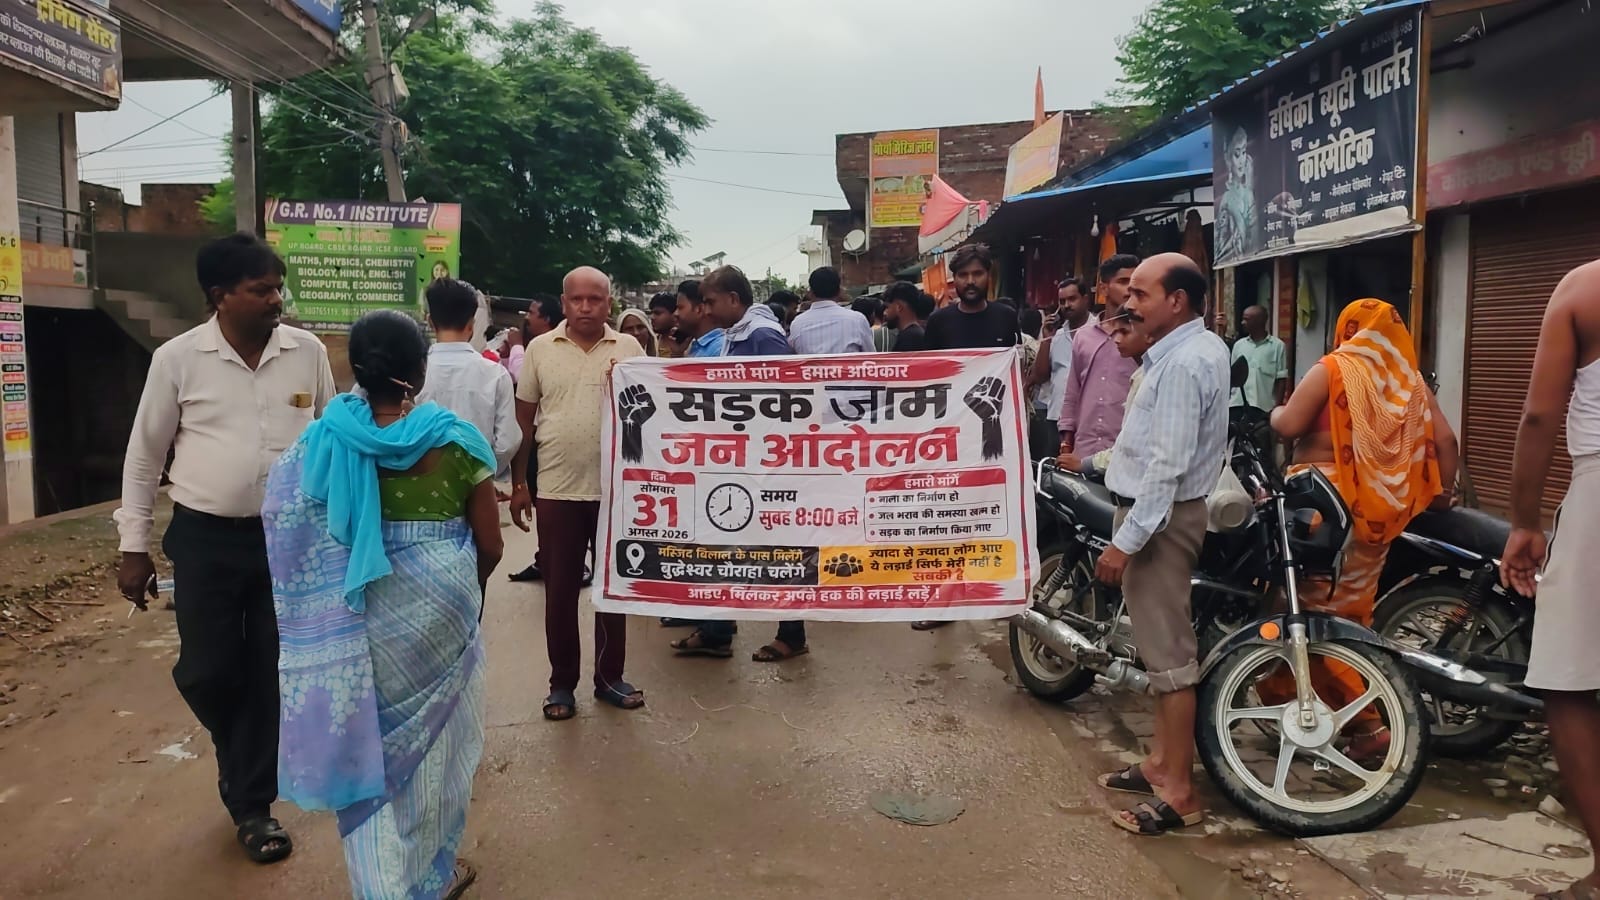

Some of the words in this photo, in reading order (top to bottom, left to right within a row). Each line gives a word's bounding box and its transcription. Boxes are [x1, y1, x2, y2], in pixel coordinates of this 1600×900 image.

[1268, 91, 1315, 140] हर्षिका
[1318, 65, 1358, 128] ब्यूटी
[1361, 40, 1413, 100] पार्लर
[1297, 127, 1376, 184] कॉस्मेटिक
[279, 202, 309, 218] G.R.
[313, 203, 345, 220] No.1
[349, 205, 429, 223] INSTITUTE
[289, 256, 322, 267] MATHS,
[323, 257, 363, 267] PHYSICS,
[365, 258, 415, 268] CHEMISTRY
[298, 267, 338, 279] BIOLOGY,
[339, 269, 366, 280] HINDI,
[368, 270, 406, 279] ENGLISH
[300, 279, 351, 290] COMPUTER,
[352, 280, 404, 291] ECONOMICS
[299, 290, 354, 302] GEOGRAPHY,
[355, 292, 405, 302] COMMERCE
[705, 364, 746, 380] हमारी
[749, 363, 780, 380] मांग
[800, 365, 842, 380] हमारा
[848, 361, 909, 378] अधिकार
[665, 387, 814, 432] सड़क
[824, 383, 952, 427] जाम
[660, 433, 750, 467] जन
[759, 423, 961, 473] आंदोलन
[650, 471, 667, 482] दिन
[904, 476, 935, 489] हमारी
[937, 473, 960, 487] मांगें
[639, 484, 676, 495] सोमवार
[760, 490, 798, 502] समय
[878, 493, 900, 504] नाला
[902, 493, 915, 503] का
[917, 491, 946, 503] निर्माण
[949, 491, 959, 502] हो
[632, 493, 678, 528] 31
[759, 509, 791, 530] सुबह
[795, 507, 834, 527] 8:00
[838, 507, 859, 526] बजे
[878, 510, 894, 520] जल
[897, 509, 919, 520] भराव
[922, 507, 935, 519] की
[936, 508, 967, 519] समस्या
[969, 506, 987, 517] खत्म
[991, 504, 1000, 515] हो
[627, 527, 658, 538] अगस्त
[661, 529, 689, 540] 2026
[879, 526, 901, 538] सड़क
[904, 525, 916, 536] का
[918, 524, 949, 536] निर्माण
[950, 524, 972, 535] किया
[974, 522, 992, 533] जाए
[658, 546, 694, 560] मस्जिद
[735, 547, 746, 560] के
[749, 551, 770, 561] पास
[773, 549, 803, 562] मिलेंगे
[869, 548, 900, 559] ज्यादा
[903, 546, 914, 557] से
[917, 547, 950, 557] ज्यादा
[953, 543, 976, 556] लोग
[980, 543, 1003, 554] आए
[660, 561, 714, 580] बुद्धेश्वर
[716, 561, 762, 579] चौराहा
[767, 562, 806, 579] चलेंगे
[869, 561, 880, 572] ये
[883, 558, 913, 572] लड़ाई
[916, 558, 942, 571] सिर्फ
[945, 556, 965, 569] मेरी
[968, 554, 990, 568] नहीं
[993, 554, 1002, 567] है
[912, 569, 952, 582] सबकी
[956, 568, 965, 581] है
[687, 587, 726, 601] आइए,
[729, 587, 780, 602] मिलकर
[783, 587, 816, 602] अपने
[820, 589, 842, 602] हक
[845, 587, 864, 601] की
[867, 586, 904, 602] लड़ाई
[907, 586, 930, 602] लड़ें
